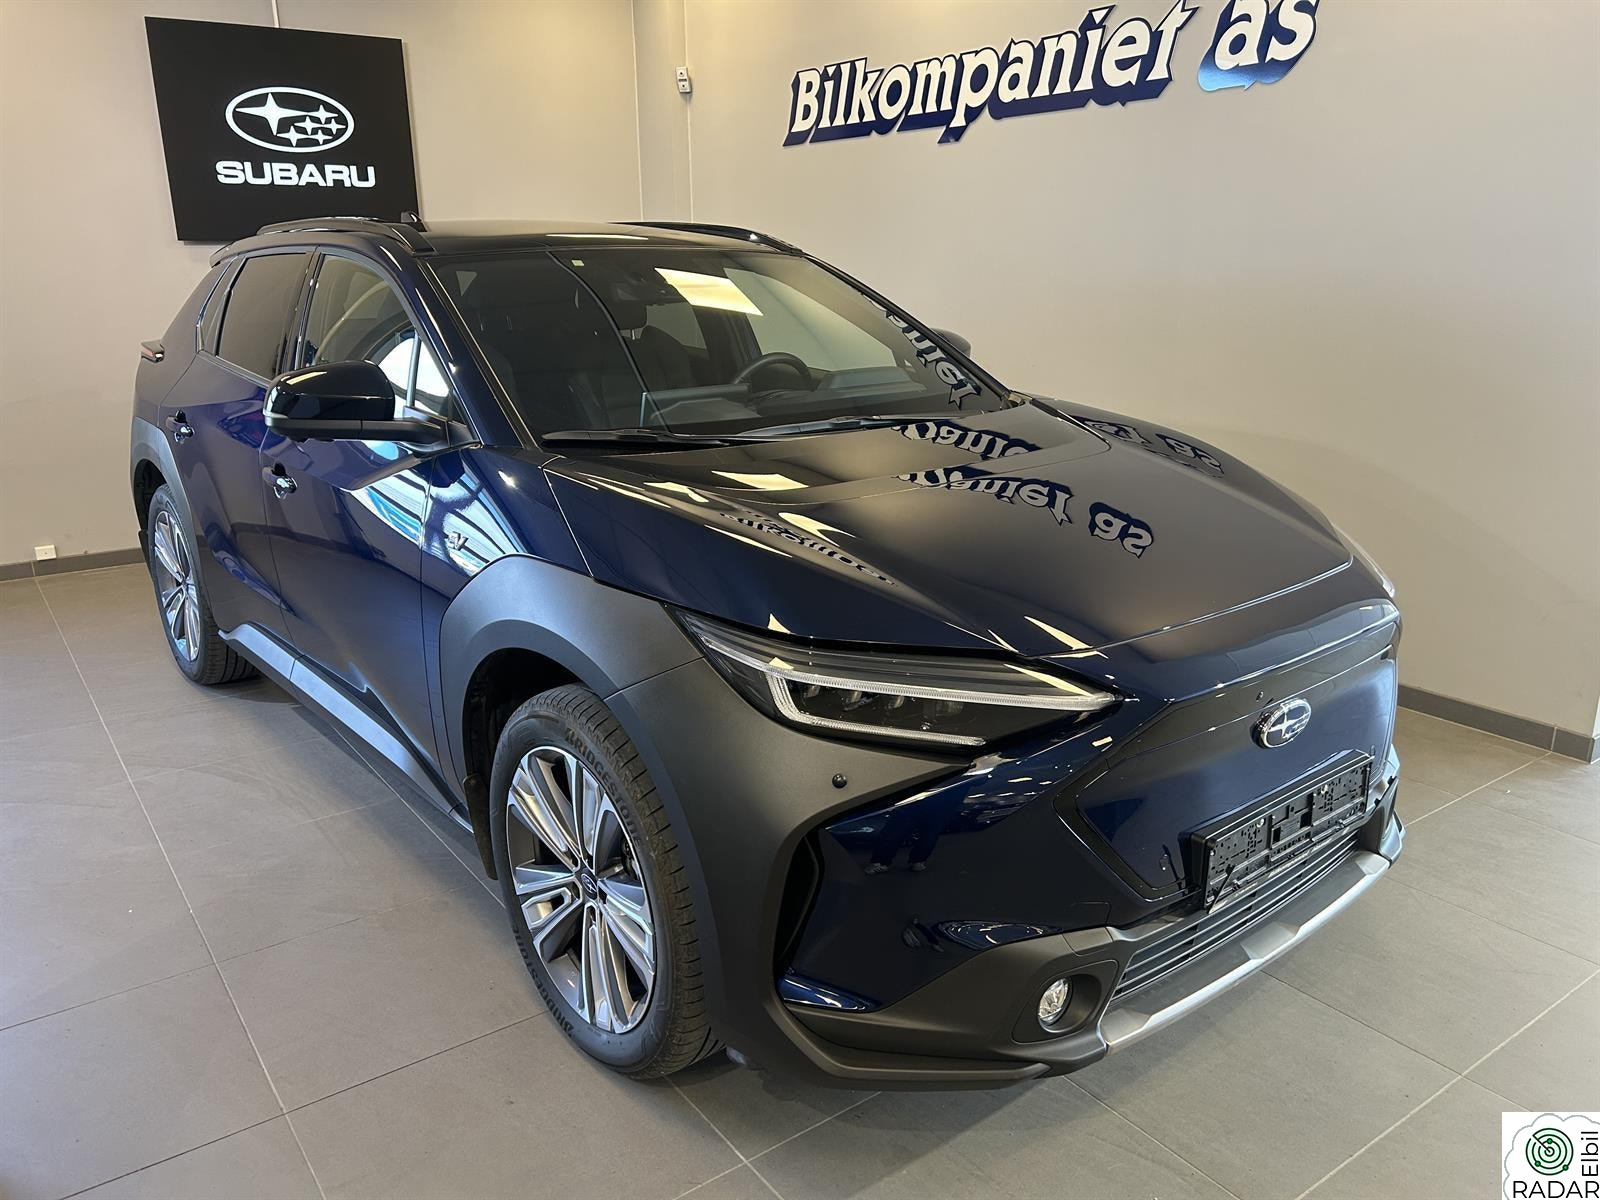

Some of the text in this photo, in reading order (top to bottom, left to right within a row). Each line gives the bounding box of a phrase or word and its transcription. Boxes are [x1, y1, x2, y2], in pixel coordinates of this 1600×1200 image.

[786, 0, 1318, 141] Bilkompaniet as
[215, 160, 376, 188] SUBARU
[564, 726, 643, 849] BRIDGESTONE
